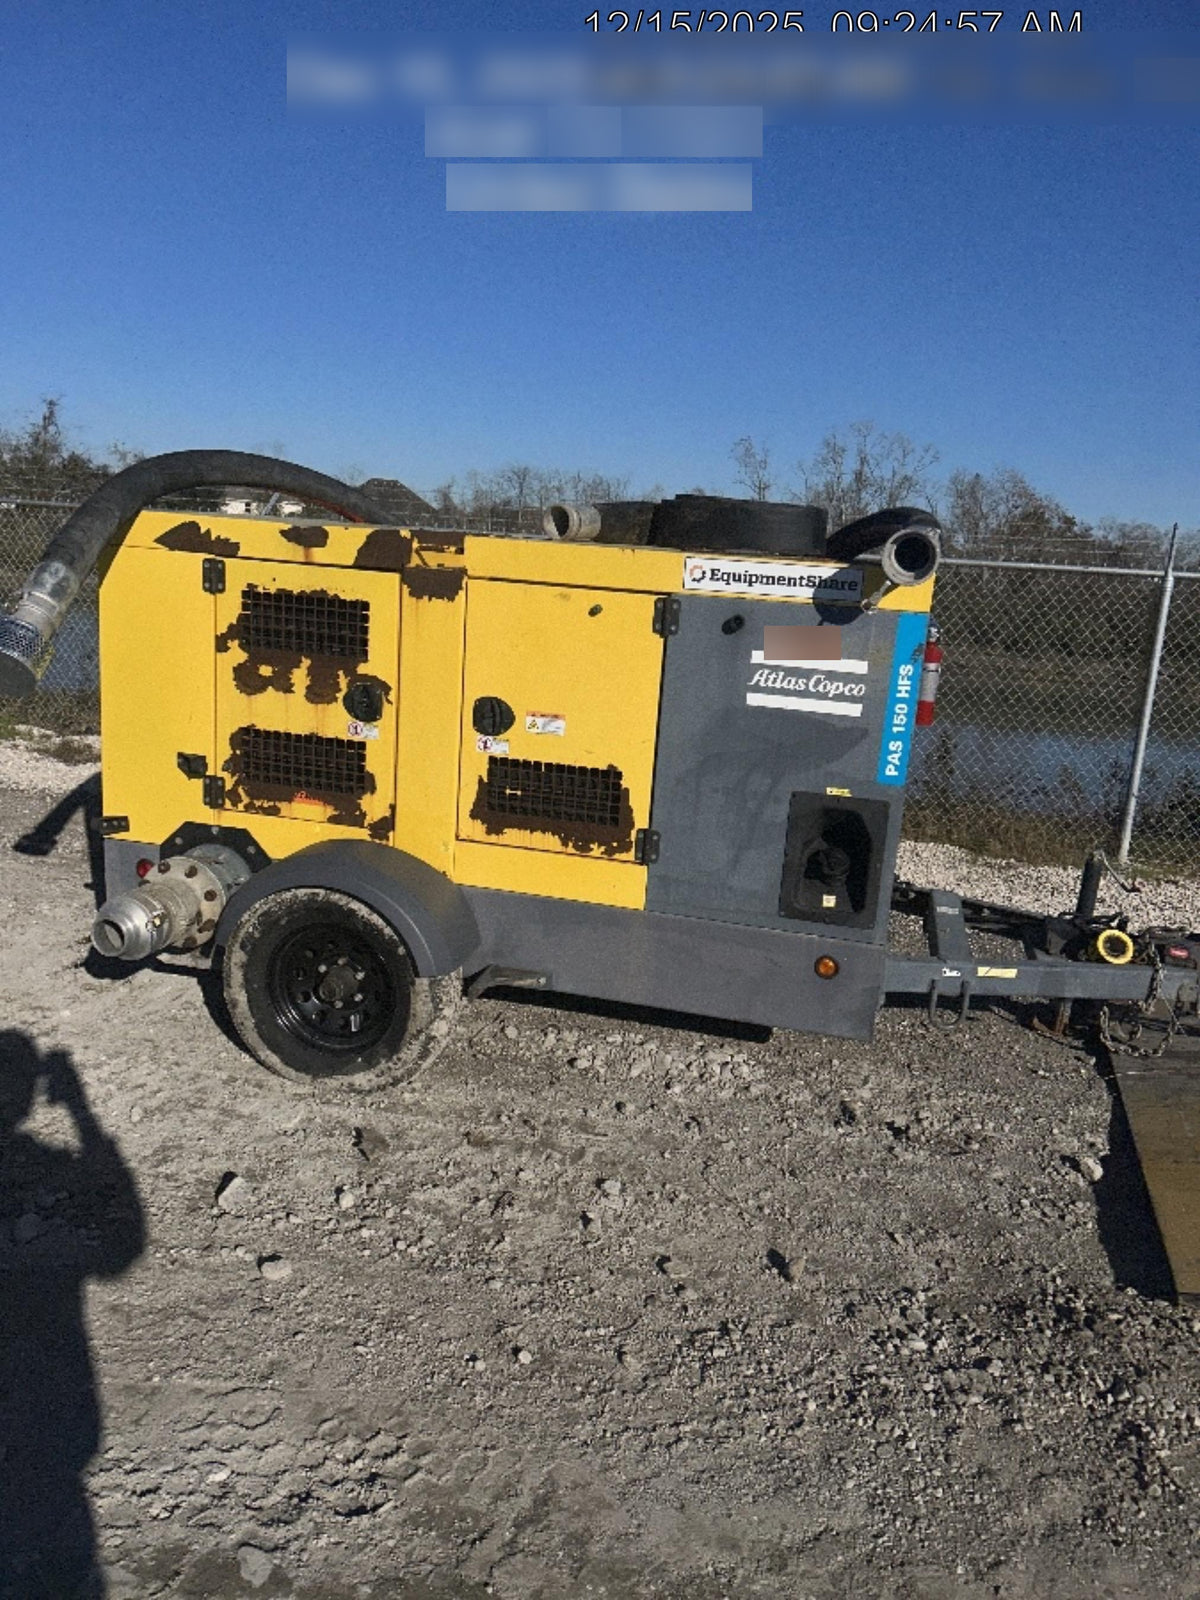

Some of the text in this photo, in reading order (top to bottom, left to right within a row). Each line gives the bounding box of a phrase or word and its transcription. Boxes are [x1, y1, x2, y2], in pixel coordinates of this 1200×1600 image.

[709, 568, 858, 591] EquipmentShare
[747, 669, 865, 698] Atlas Copco
[885, 664, 914, 777] PAS 150 HFS
